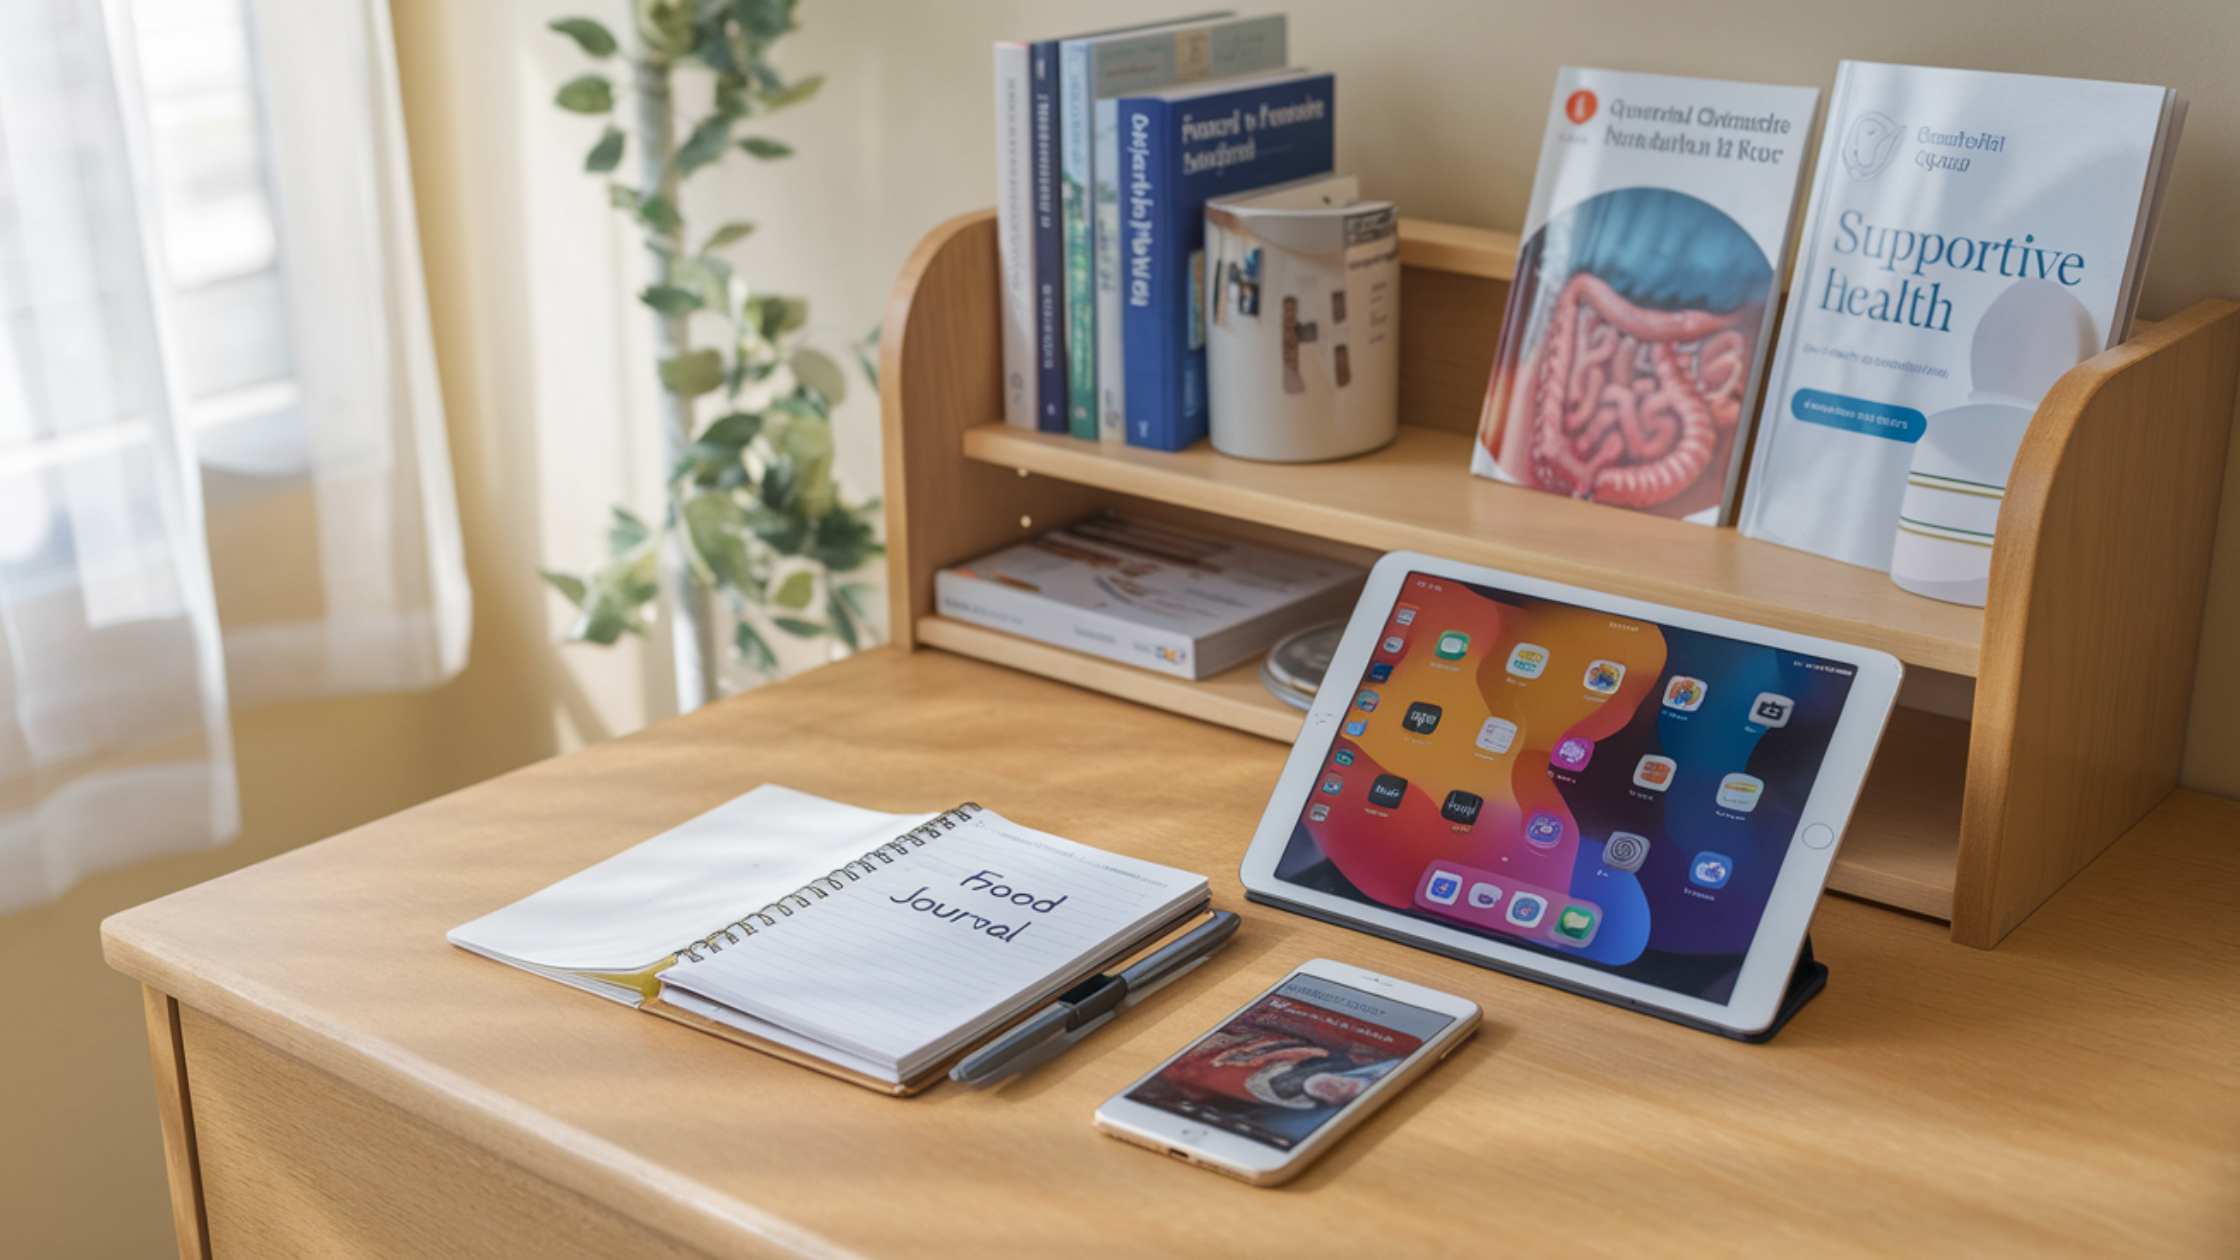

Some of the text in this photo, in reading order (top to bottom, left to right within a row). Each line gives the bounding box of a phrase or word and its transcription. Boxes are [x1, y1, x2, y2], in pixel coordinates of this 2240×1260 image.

[1834, 209, 2085, 286] Supportive
[1818, 266, 1953, 332] Health
[960, 870, 1068, 913] Food
